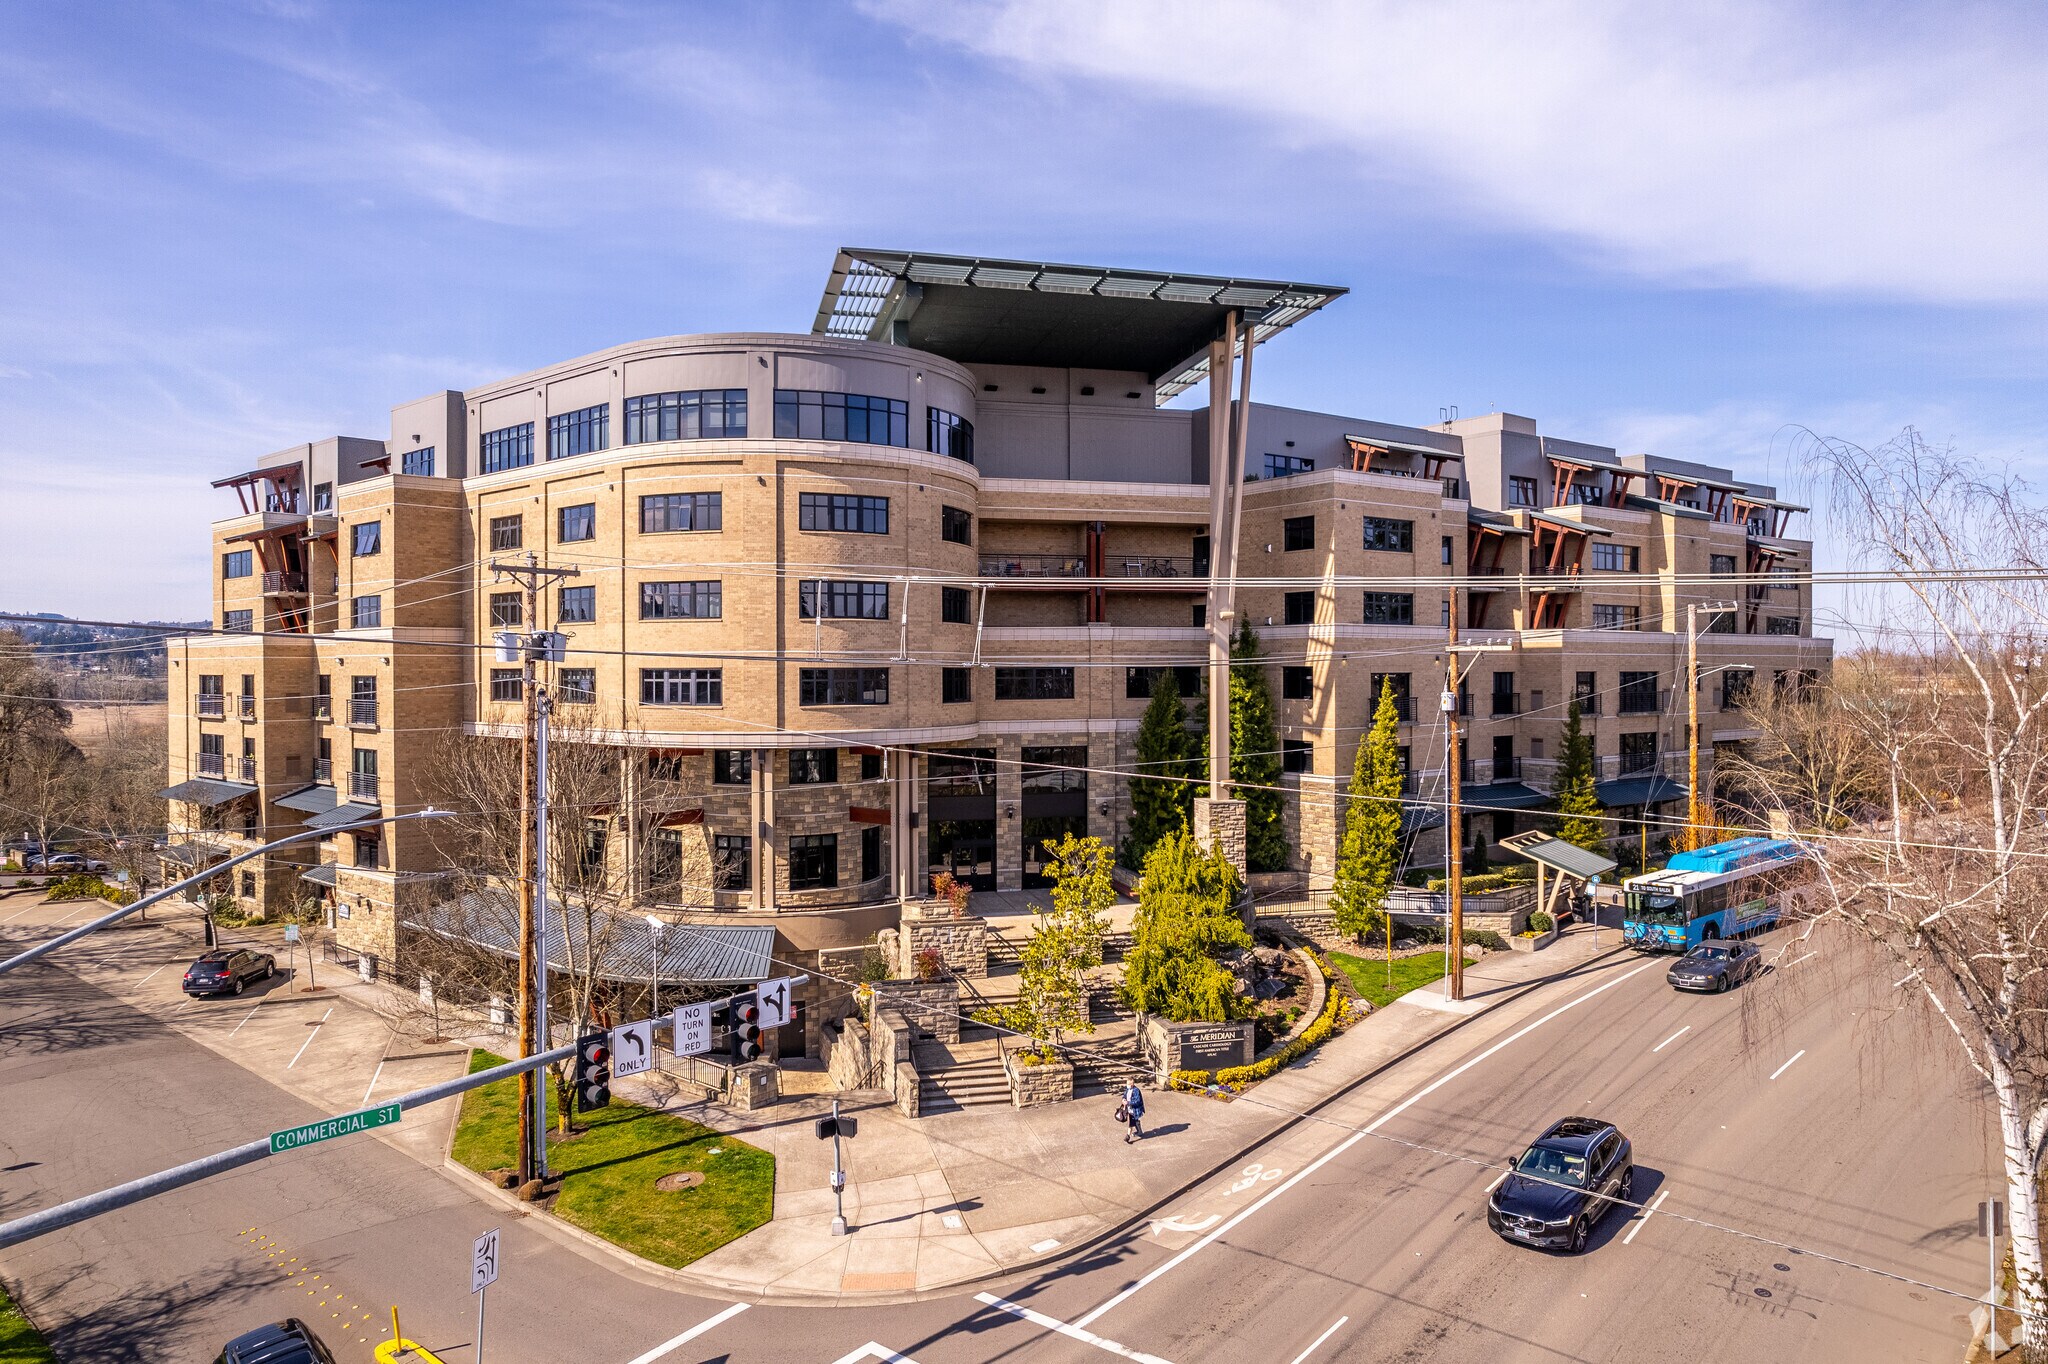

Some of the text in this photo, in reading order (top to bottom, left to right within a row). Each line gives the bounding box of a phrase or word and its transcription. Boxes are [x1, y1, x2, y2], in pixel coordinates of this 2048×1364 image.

[684, 1008, 700, 1021] NO
[682, 1019, 704, 1031] TURN
[687, 1031, 699, 1041] ON
[1200, 1031, 1236, 1041] MERIDIAN
[684, 1041, 701, 1052] RED
[619, 1058, 647, 1074] ONLY
[276, 1107, 395, 1149] COMMERCIAL ST
